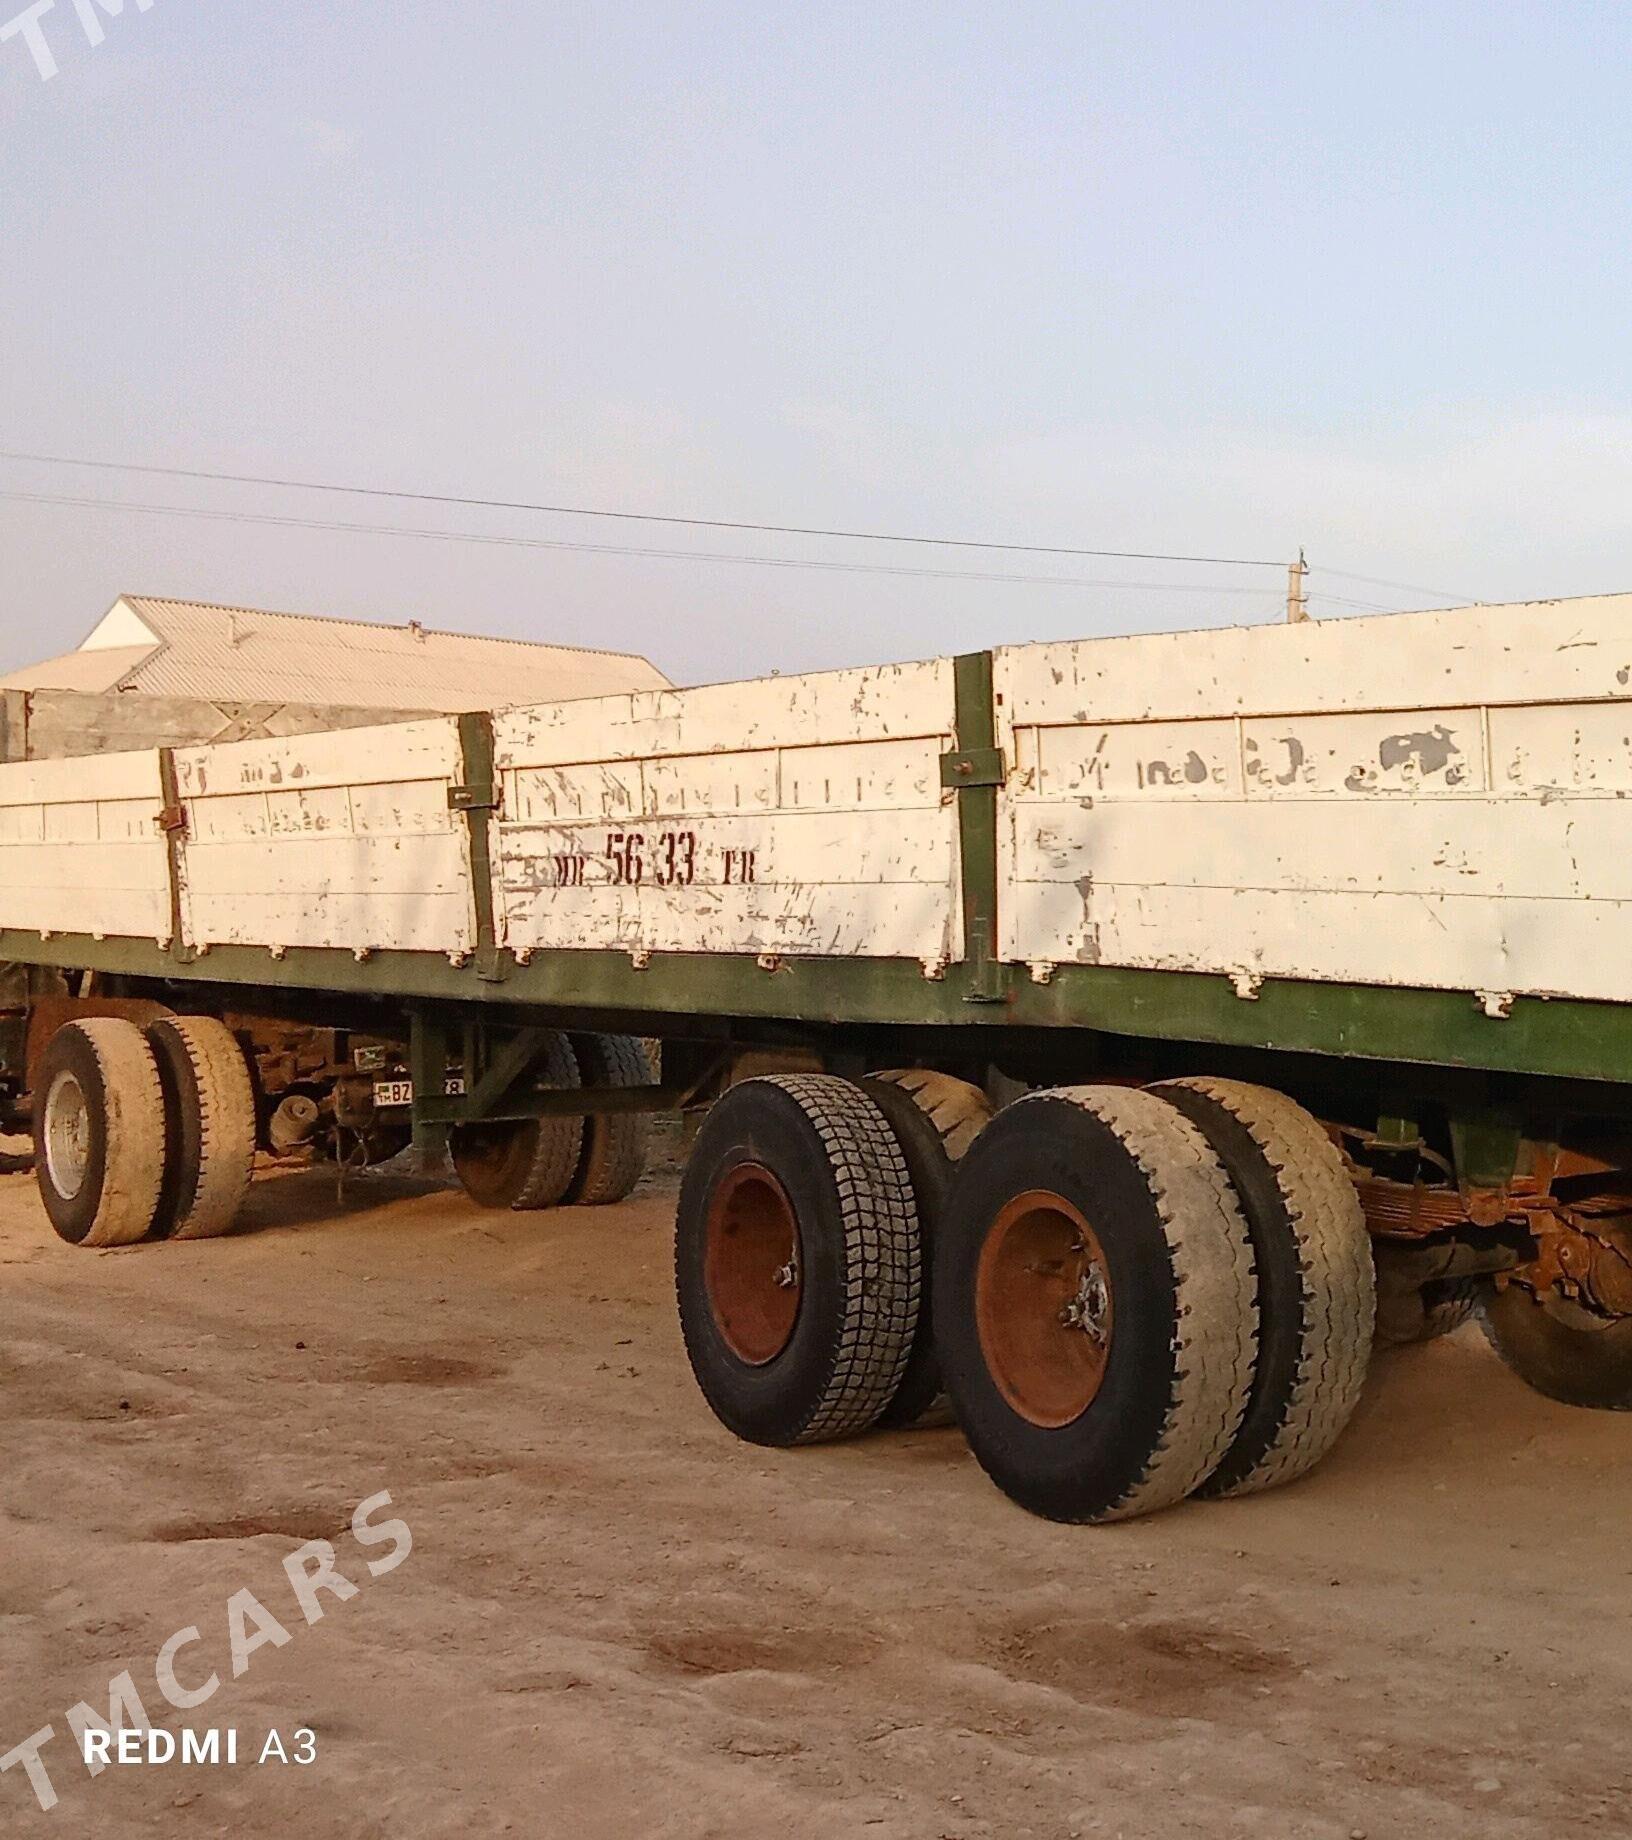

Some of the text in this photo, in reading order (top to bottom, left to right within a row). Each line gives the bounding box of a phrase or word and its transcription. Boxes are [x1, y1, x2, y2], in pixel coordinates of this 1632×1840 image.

[606, 833, 644, 885] 56
[657, 831, 695, 886] 33
[721, 850, 755, 885] TR
